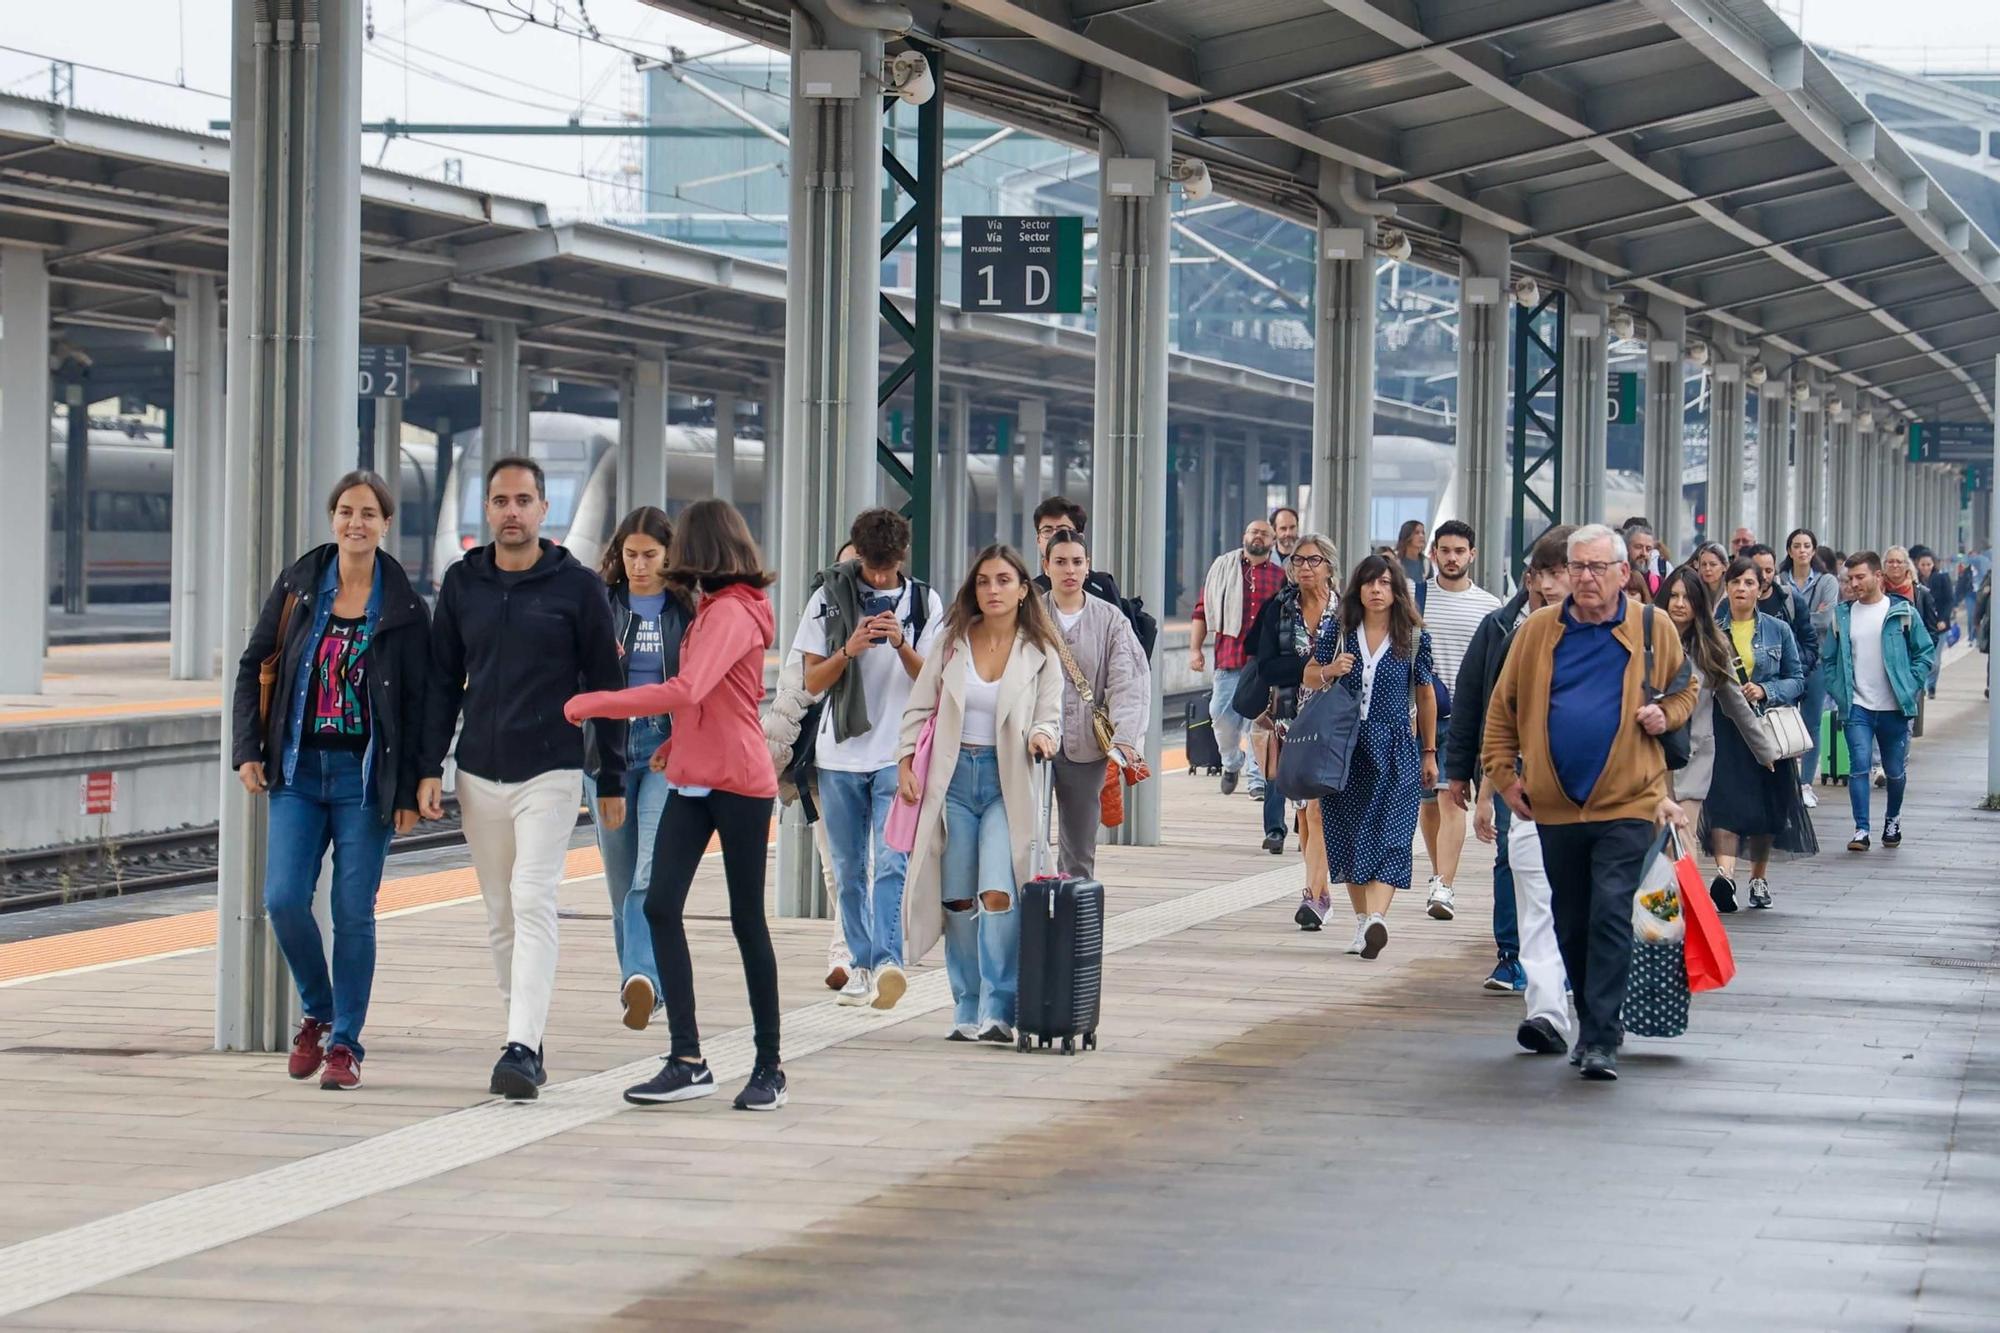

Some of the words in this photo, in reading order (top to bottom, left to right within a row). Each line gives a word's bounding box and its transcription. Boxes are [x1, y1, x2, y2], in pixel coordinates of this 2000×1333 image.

[1020, 220, 1050, 230] Sector
[1019, 232, 1050, 242] Sector
[978, 265, 1002, 306] 1
[1025, 265, 1050, 306] D
[359, 371, 373, 394] D
[384, 372, 397, 395] 2
[986, 435, 996, 450] 2
[1921, 441, 1929, 457] 1
